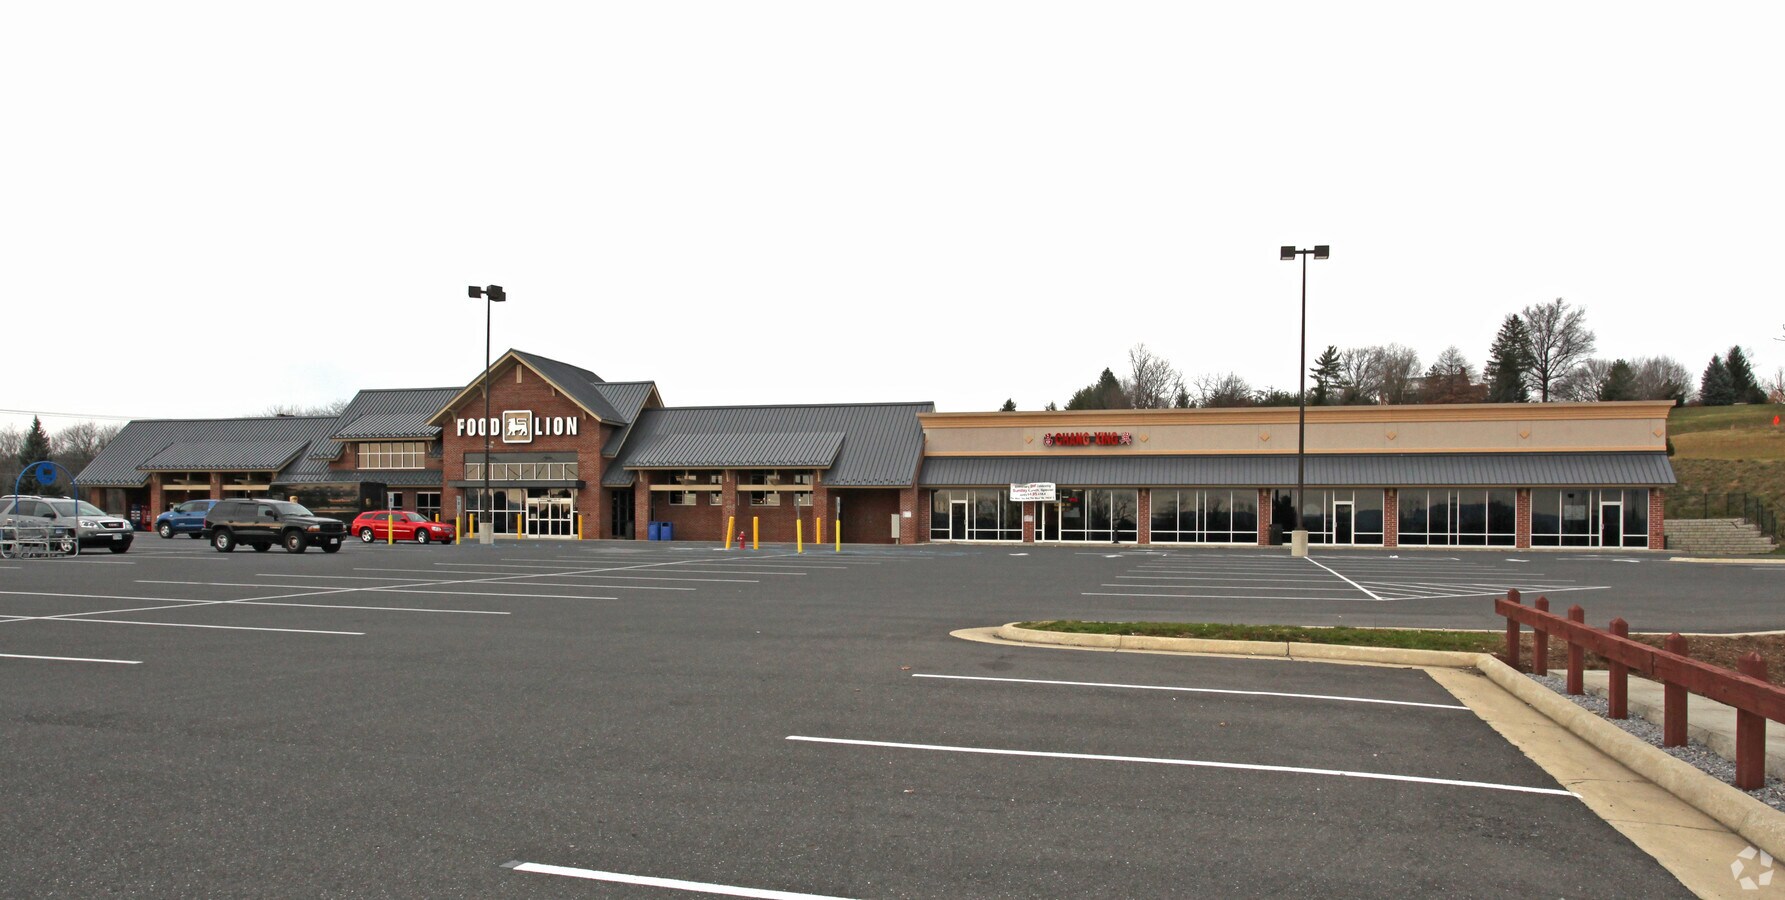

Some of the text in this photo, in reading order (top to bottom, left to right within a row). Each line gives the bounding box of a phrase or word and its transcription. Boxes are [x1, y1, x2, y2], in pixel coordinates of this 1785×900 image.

[456, 416, 578, 437] FOOD LION
[1055, 432, 1090, 446] CHANG
[1094, 432, 1118, 445] XING
